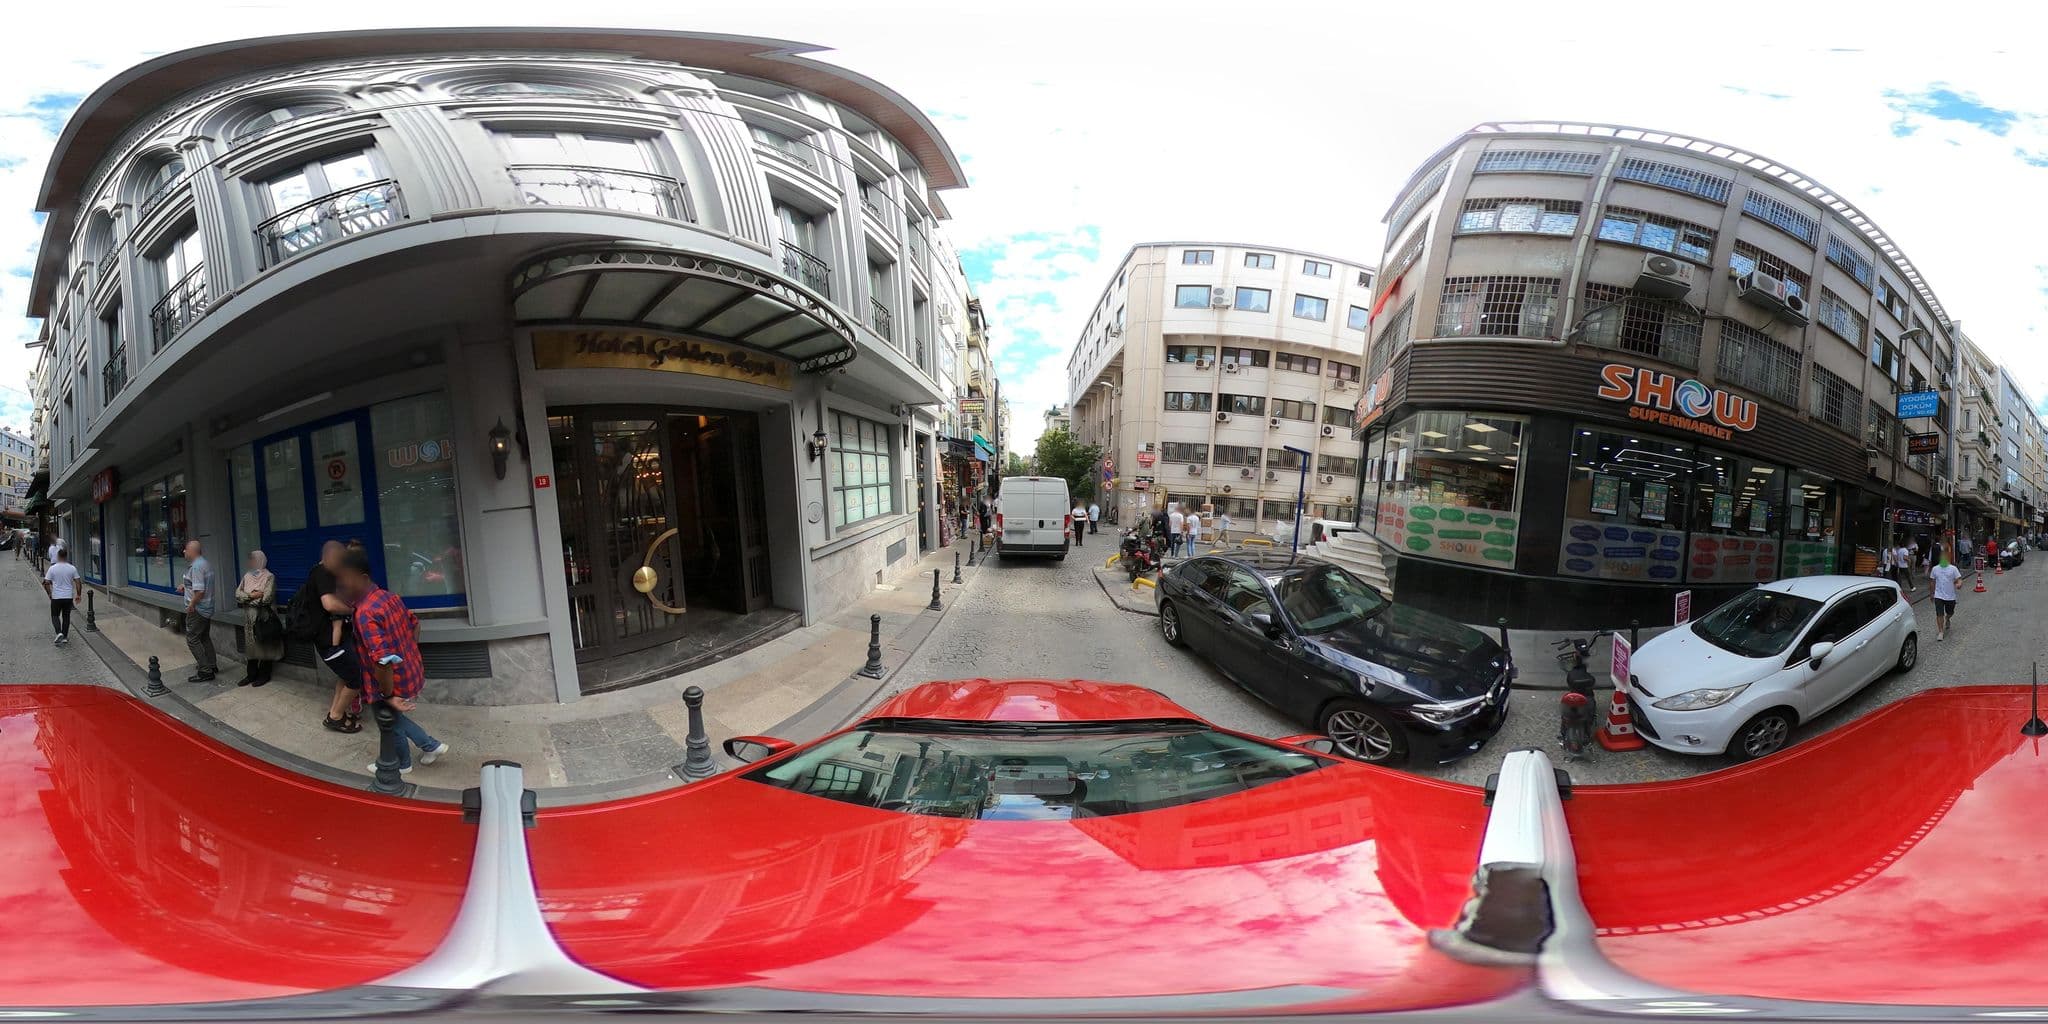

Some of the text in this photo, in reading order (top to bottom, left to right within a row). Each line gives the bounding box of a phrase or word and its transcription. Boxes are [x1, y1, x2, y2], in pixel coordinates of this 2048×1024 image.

[1598, 363, 1759, 432] SHOW
[1628, 405, 1734, 441] SUPERMARKET
[1910, 438, 1938, 447] SHOW
[1439, 540, 1477, 554] SHOW
